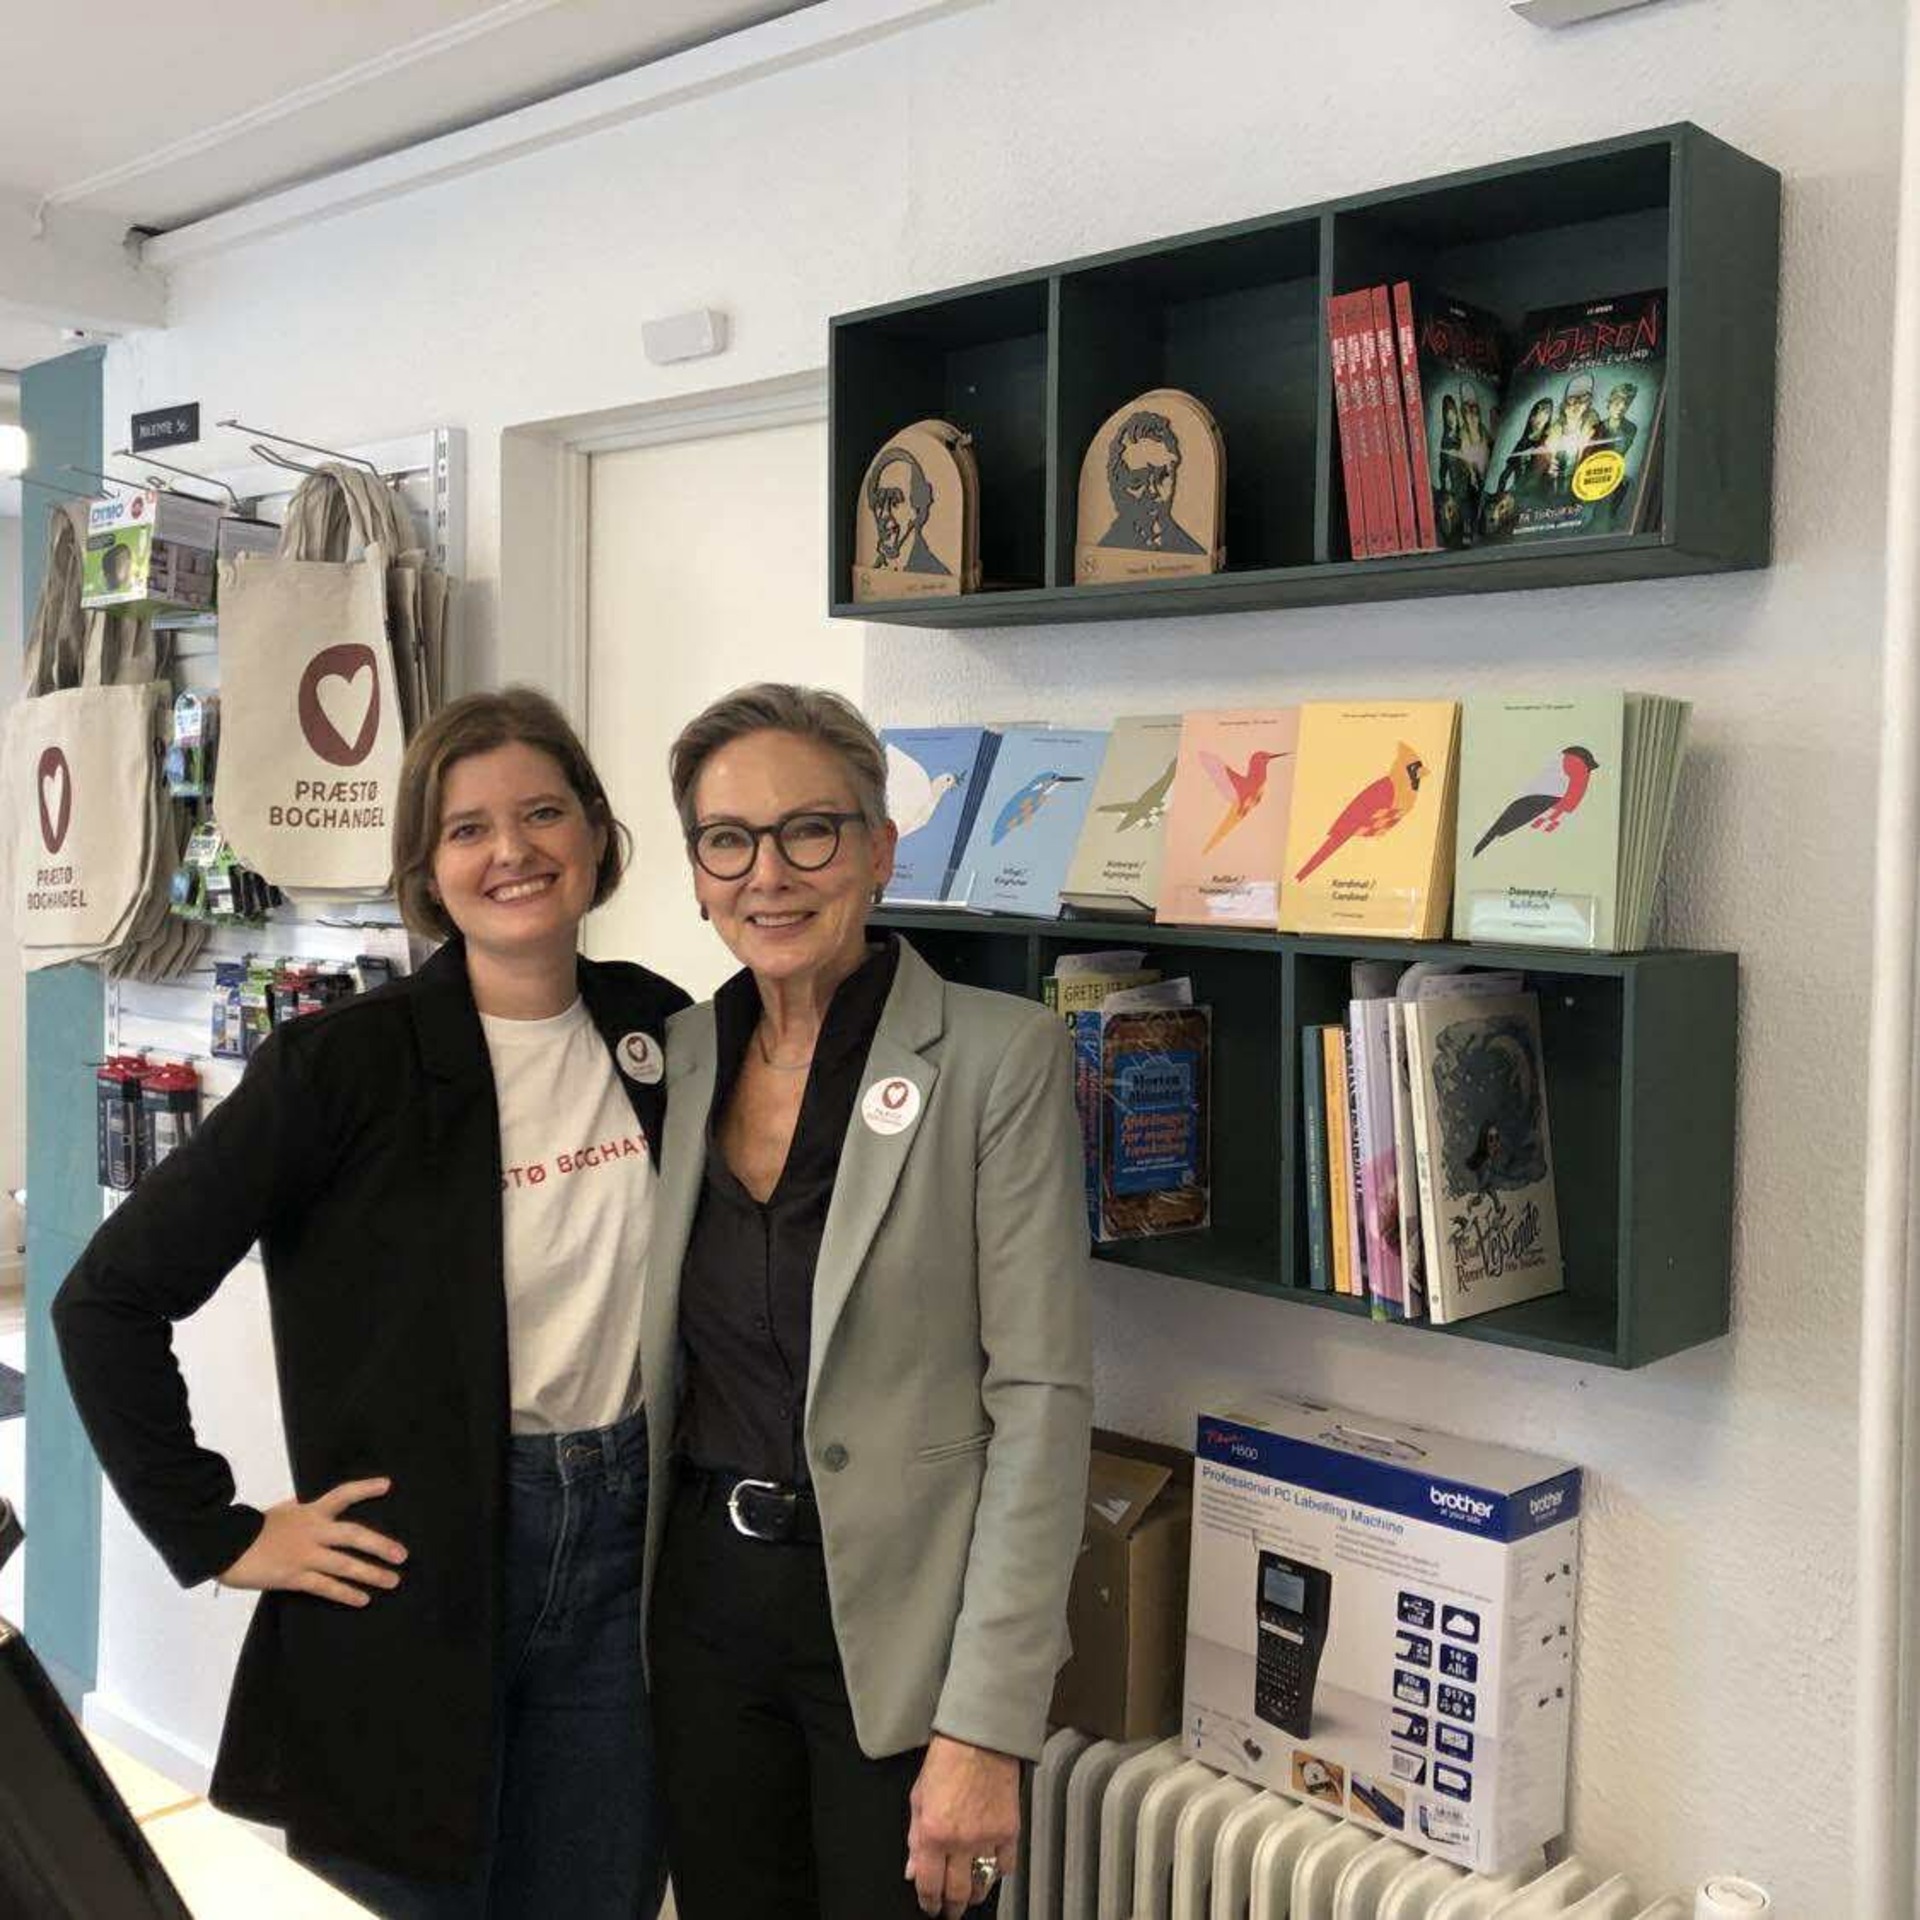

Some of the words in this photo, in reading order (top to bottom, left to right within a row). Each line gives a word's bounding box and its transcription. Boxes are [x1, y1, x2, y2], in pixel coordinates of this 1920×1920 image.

[295, 780, 378, 802] PRÆSTØ
[269, 806, 385, 829] BOGHANDEL
[1202, 1465, 1270, 1497] Professional
[1274, 1489, 1291, 1501] PC
[1294, 1493, 1348, 1521] Labelling
[1351, 1509, 1404, 1534] Machine
[1430, 1486, 1494, 1519] brother
[1530, 1489, 1565, 1515] brother
